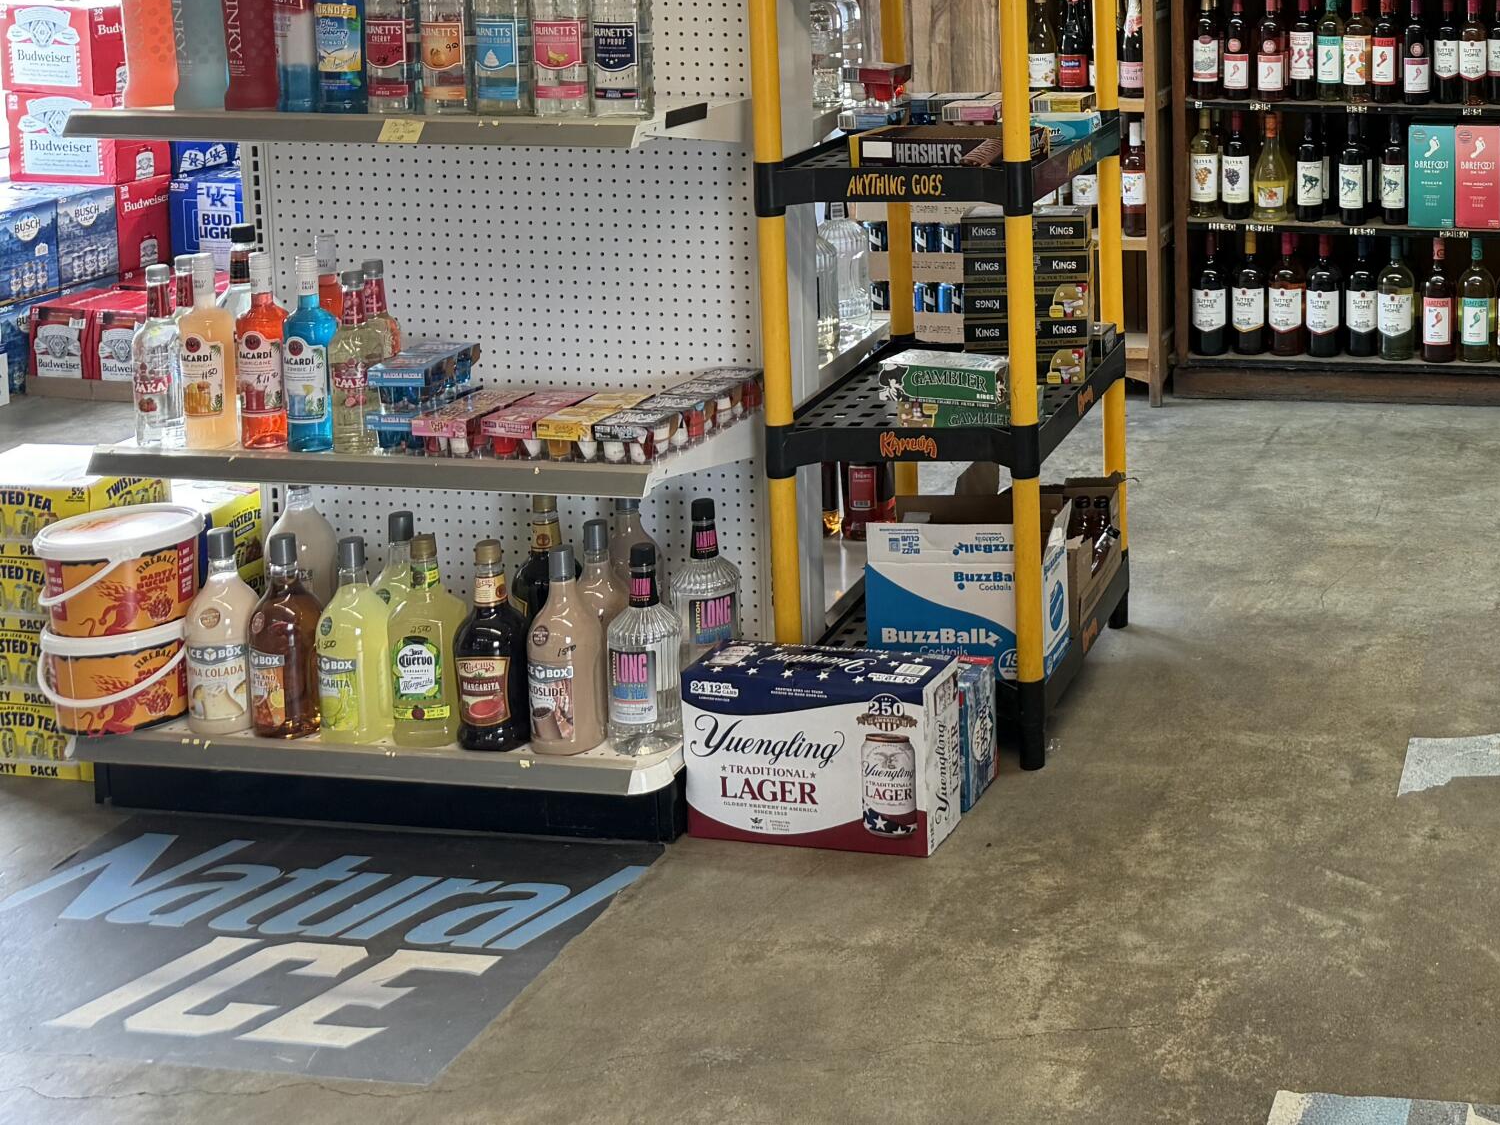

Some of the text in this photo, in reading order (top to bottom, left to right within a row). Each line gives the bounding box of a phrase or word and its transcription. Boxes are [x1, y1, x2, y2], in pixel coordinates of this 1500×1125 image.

[535, 26, 577, 36] BURNETT'S
[594, 27, 635, 37] BURNETT'S
[17, 49, 72, 63] Budweiser
[30, 139, 92, 153] Budweiser
[895, 141, 963, 165] HERSHEY'S
[1415, 161, 1449, 169] BAREFOOT
[1460, 161, 1495, 169] BAREFOOT
[847, 173, 943, 197] ANYTHING GOES
[123, 193, 169, 213] Budweiser
[74, 203, 100, 218] BUSCH
[14, 217, 42, 234] BUSCH
[202, 213, 232, 226] BUD
[200, 226, 232, 239] LIGH
[972, 226, 996, 236] KINGS
[1049, 226, 1074, 235] KINGS
[975, 261, 999, 271] KINGS
[1052, 260, 1077, 270] KINGS
[975, 300, 1000, 309] KINGS
[975, 328, 1000, 338] KINGS
[1052, 325, 1077, 334] KINGS
[181, 351, 212, 362] ACARDÍ
[38, 358, 81, 370] Budweiser
[911, 369, 988, 392] GAMBLER
[28, 494, 52, 511] TEA
[136, 555, 177, 574] FIREBALL
[978, 583, 1012, 592] Cocktails
[701, 597, 732, 629] LONG
[881, 627, 1003, 648] BuzzBallz
[218, 645, 242, 658] BOX
[919, 645, 968, 657] Cocktails
[259, 655, 280, 666] BOX
[331, 659, 353, 670] BOX
[399, 654, 433, 669] Cuervo
[205, 665, 244, 678] COLADA
[616, 652, 648, 683] LONG
[463, 681, 500, 692] MARGARITA
[690, 682, 722, 695] 24 12
[868, 700, 905, 717] 250
[690, 714, 845, 769] Yuengling
[30, 765, 58, 777] PACK
[729, 764, 810, 779] TRADITIONAL
[862, 760, 914, 782] Yuengling
[932, 720, 950, 825] Yuengling
[720, 775, 819, 805] LAGER
[866, 785, 913, 803] LAGER
[0, 832, 648, 950] Natural
[42, 936, 503, 1048] ICE
